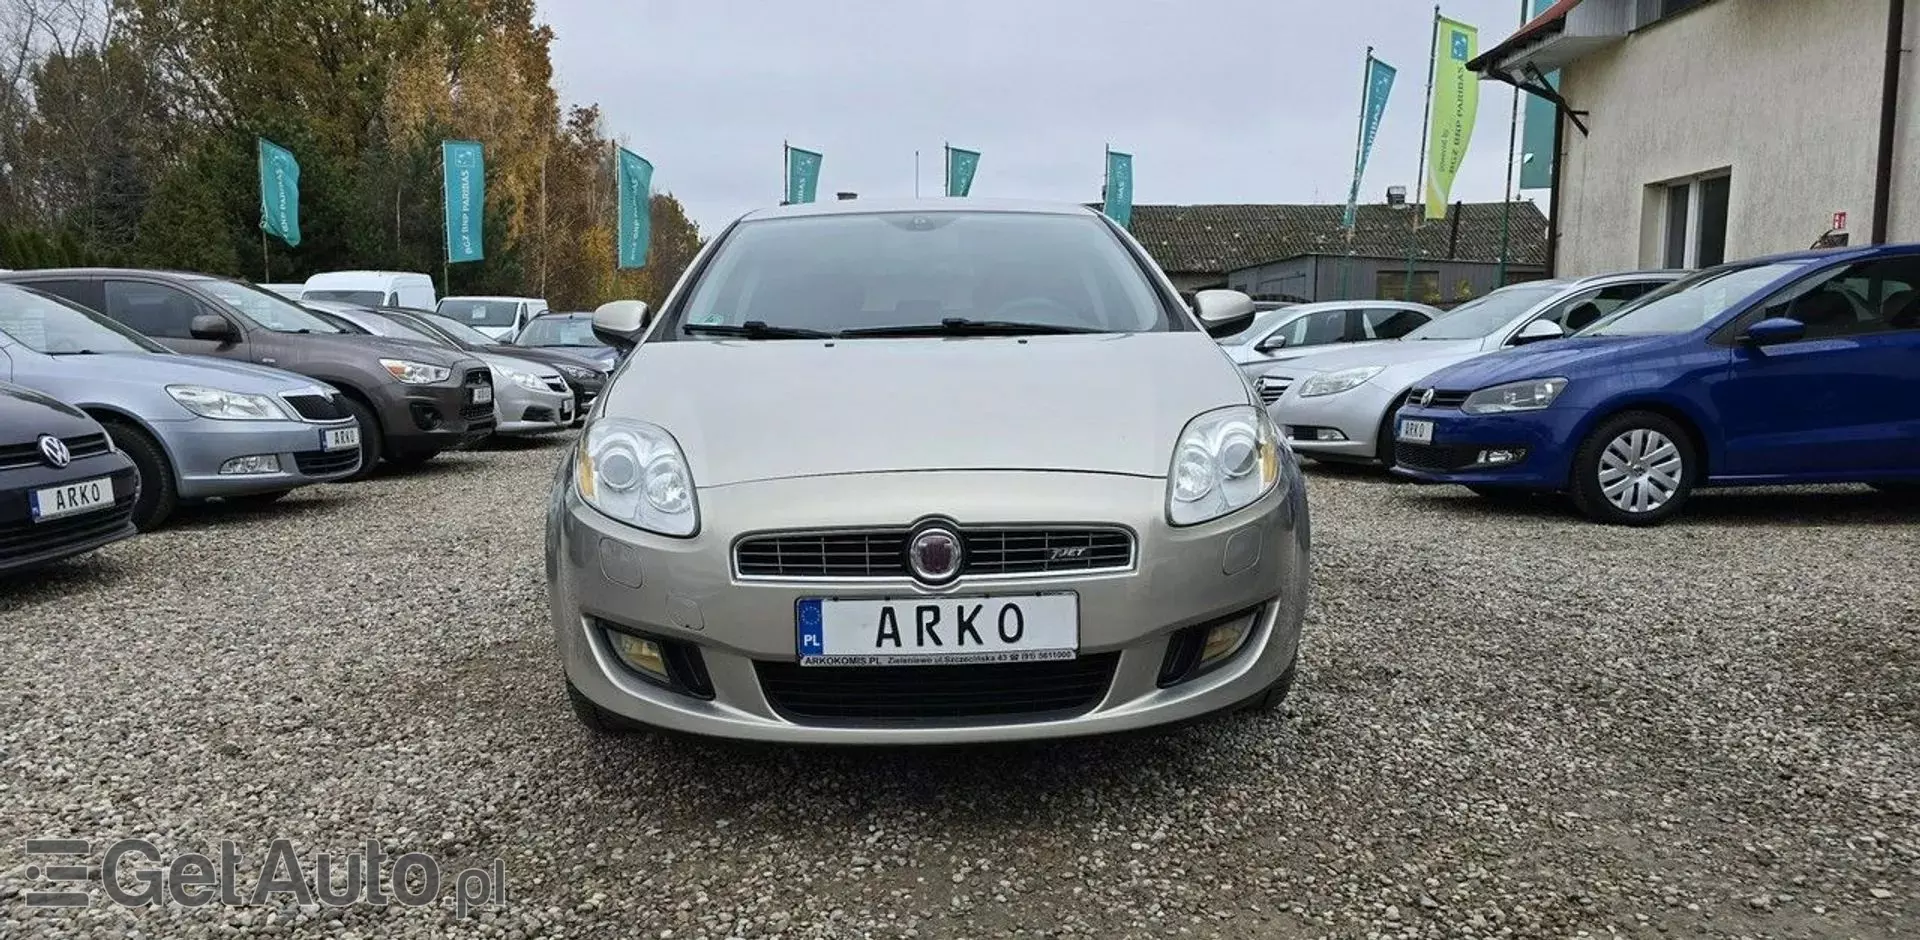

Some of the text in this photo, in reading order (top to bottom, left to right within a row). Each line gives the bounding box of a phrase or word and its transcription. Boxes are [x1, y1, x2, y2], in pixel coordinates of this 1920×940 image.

[56, 483, 100, 510] ARKO
[876, 602, 1024, 648] ARKO
[803, 634, 820, 646] PL
